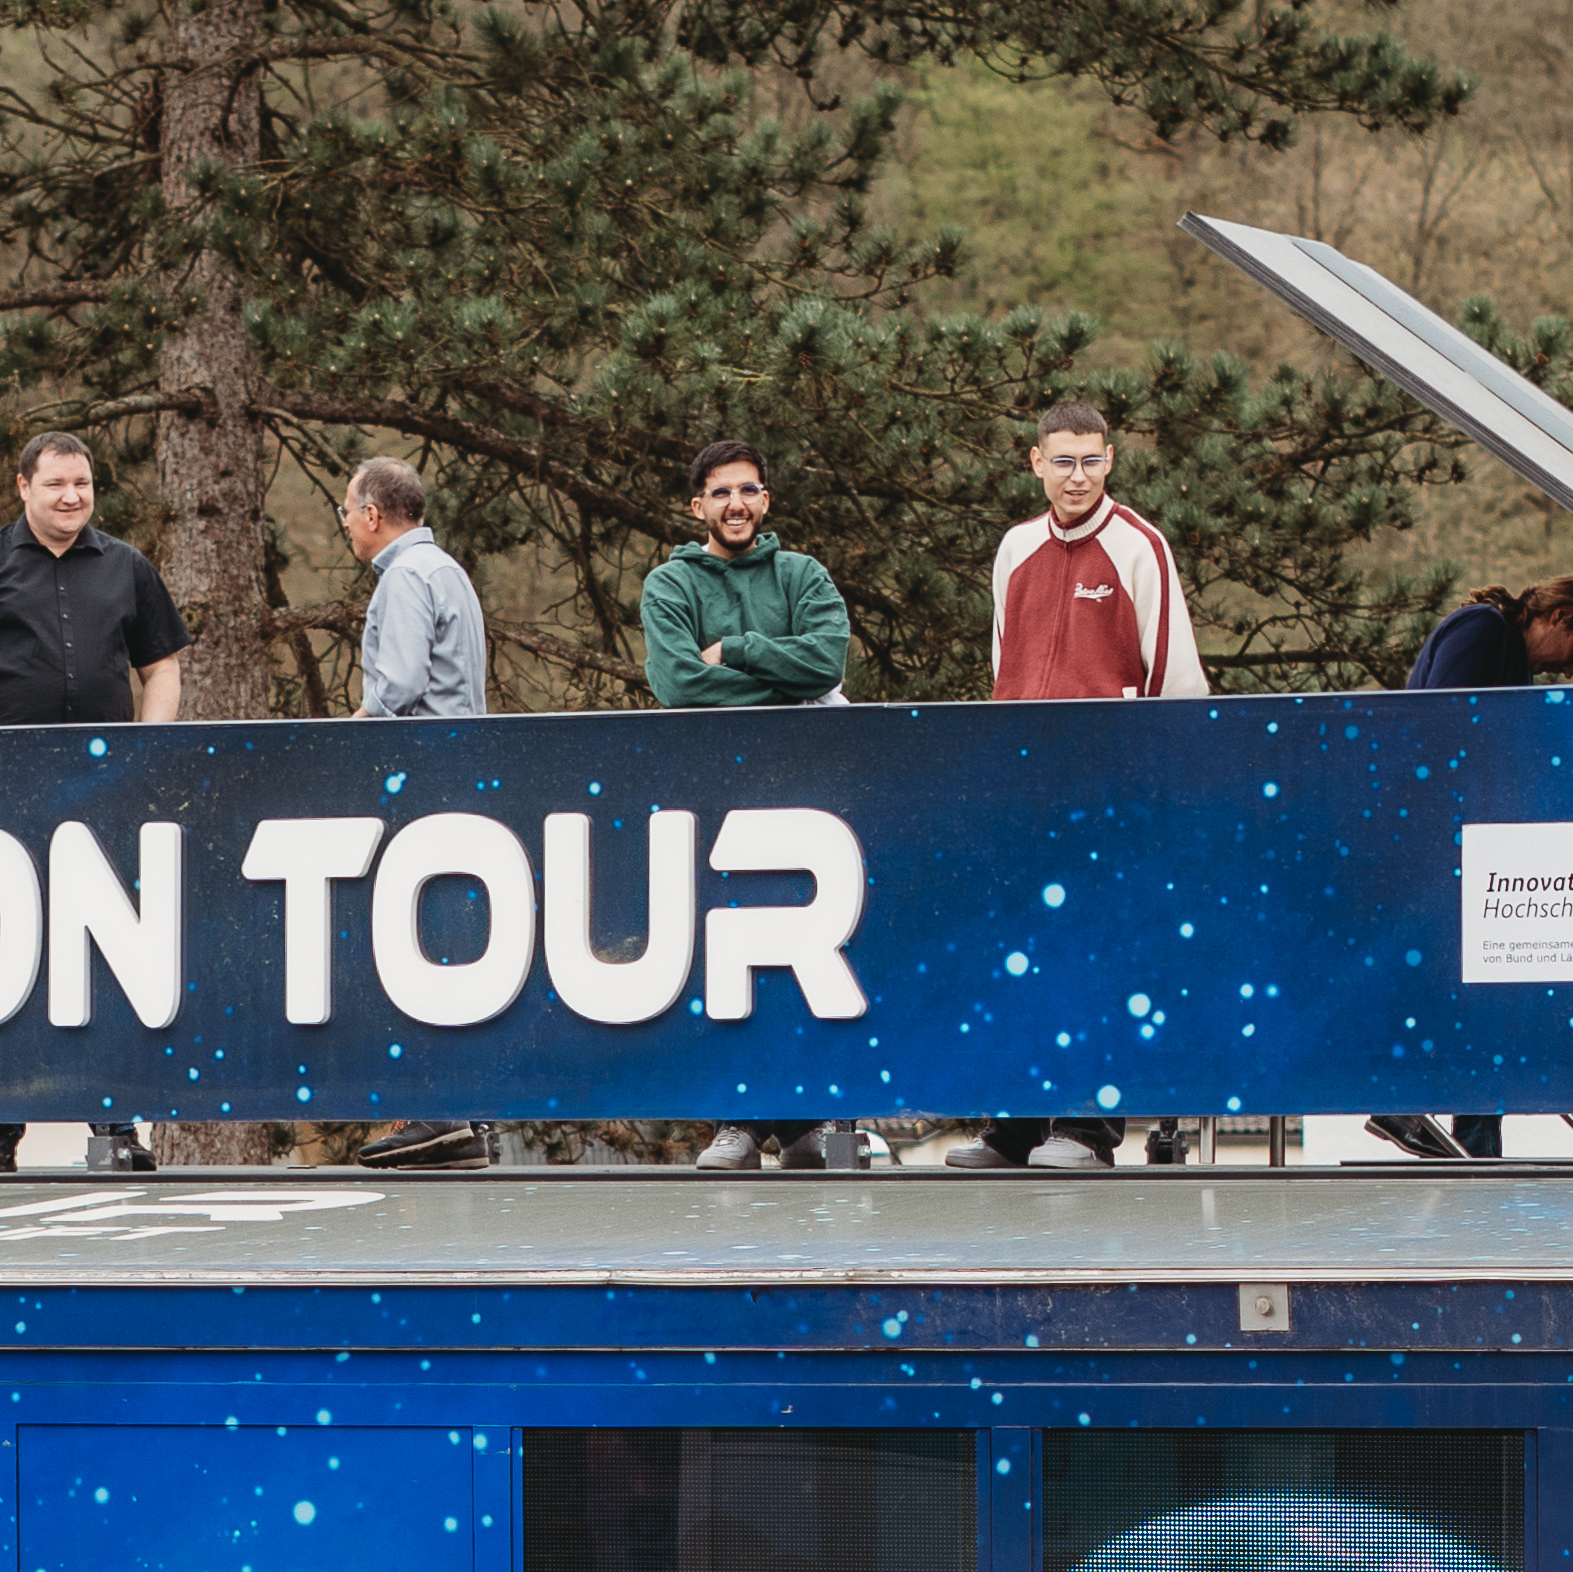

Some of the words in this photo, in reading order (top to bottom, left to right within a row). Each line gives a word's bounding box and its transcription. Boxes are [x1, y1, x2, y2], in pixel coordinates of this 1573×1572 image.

[241, 807, 868, 1026] TOUR
[1482, 940, 1506, 950] Eine
[1482, 955, 1502, 964] von
[1506, 954, 1533, 964] Bund
[1536, 954, 1557, 963] und
